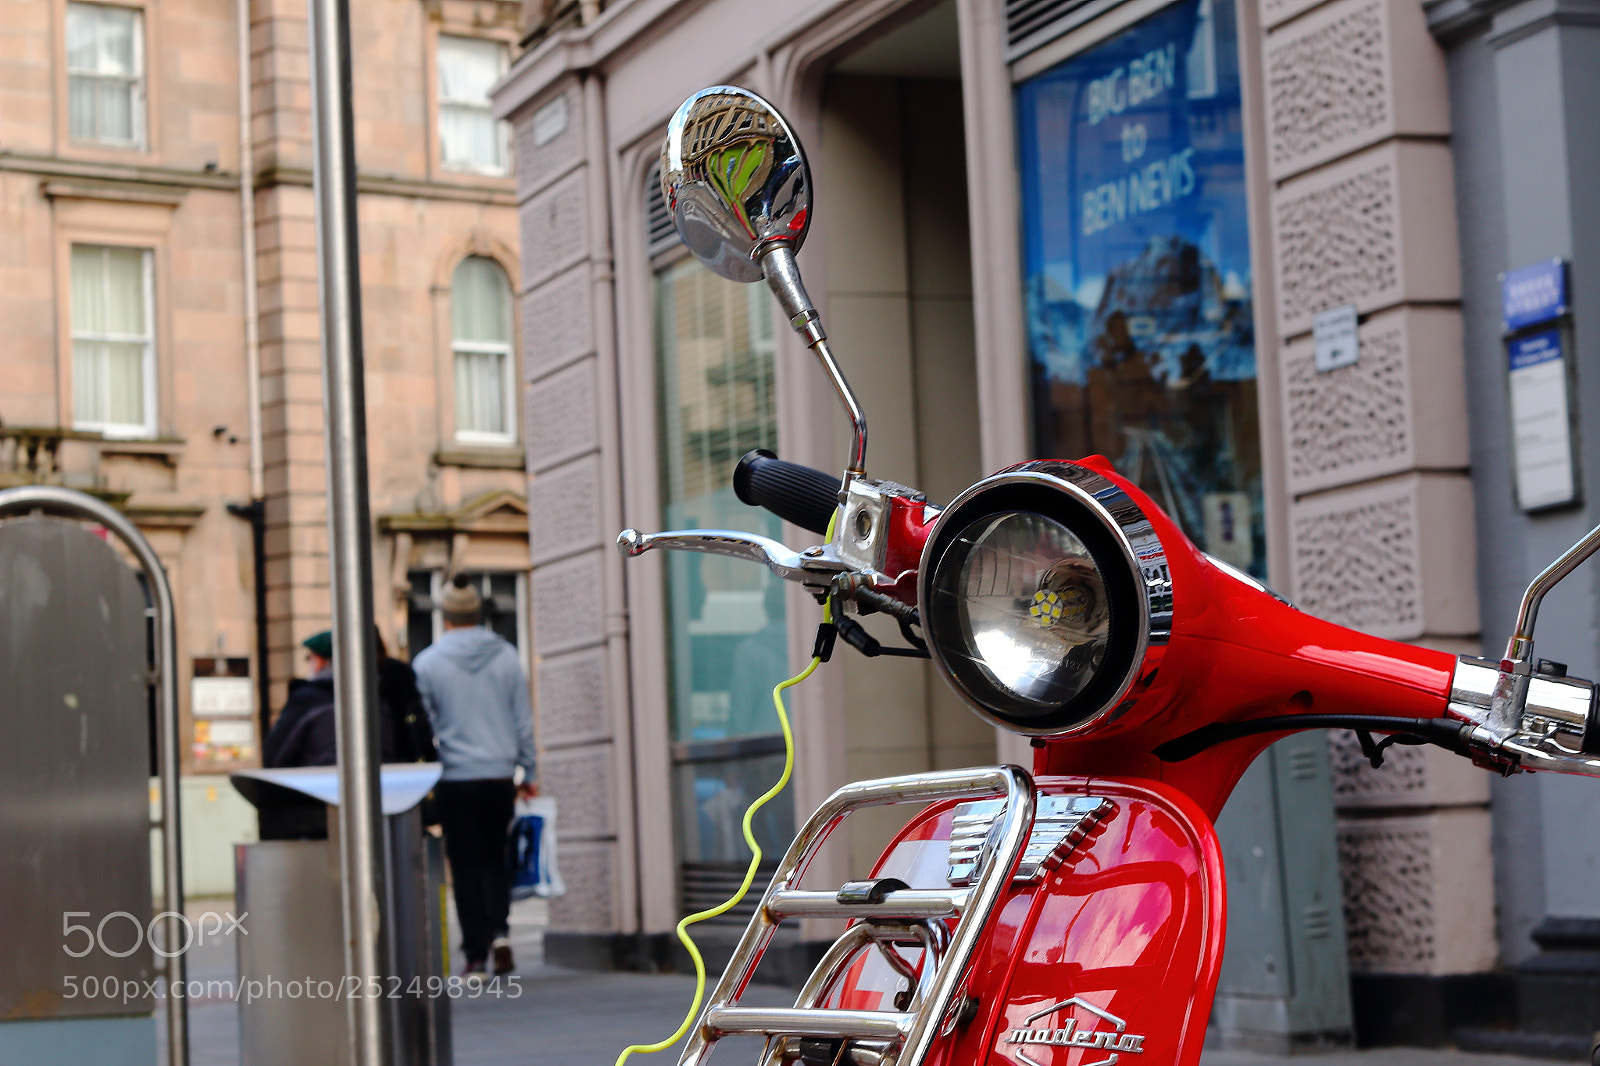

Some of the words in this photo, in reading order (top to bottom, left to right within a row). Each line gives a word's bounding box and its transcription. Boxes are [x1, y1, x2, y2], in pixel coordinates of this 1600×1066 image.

[1087, 67, 1127, 126] BIG
[1128, 42, 1176, 107] BEN
[1120, 121, 1149, 164] to
[1082, 177, 1128, 237] BEN
[1129, 147, 1197, 216] NEVIS
